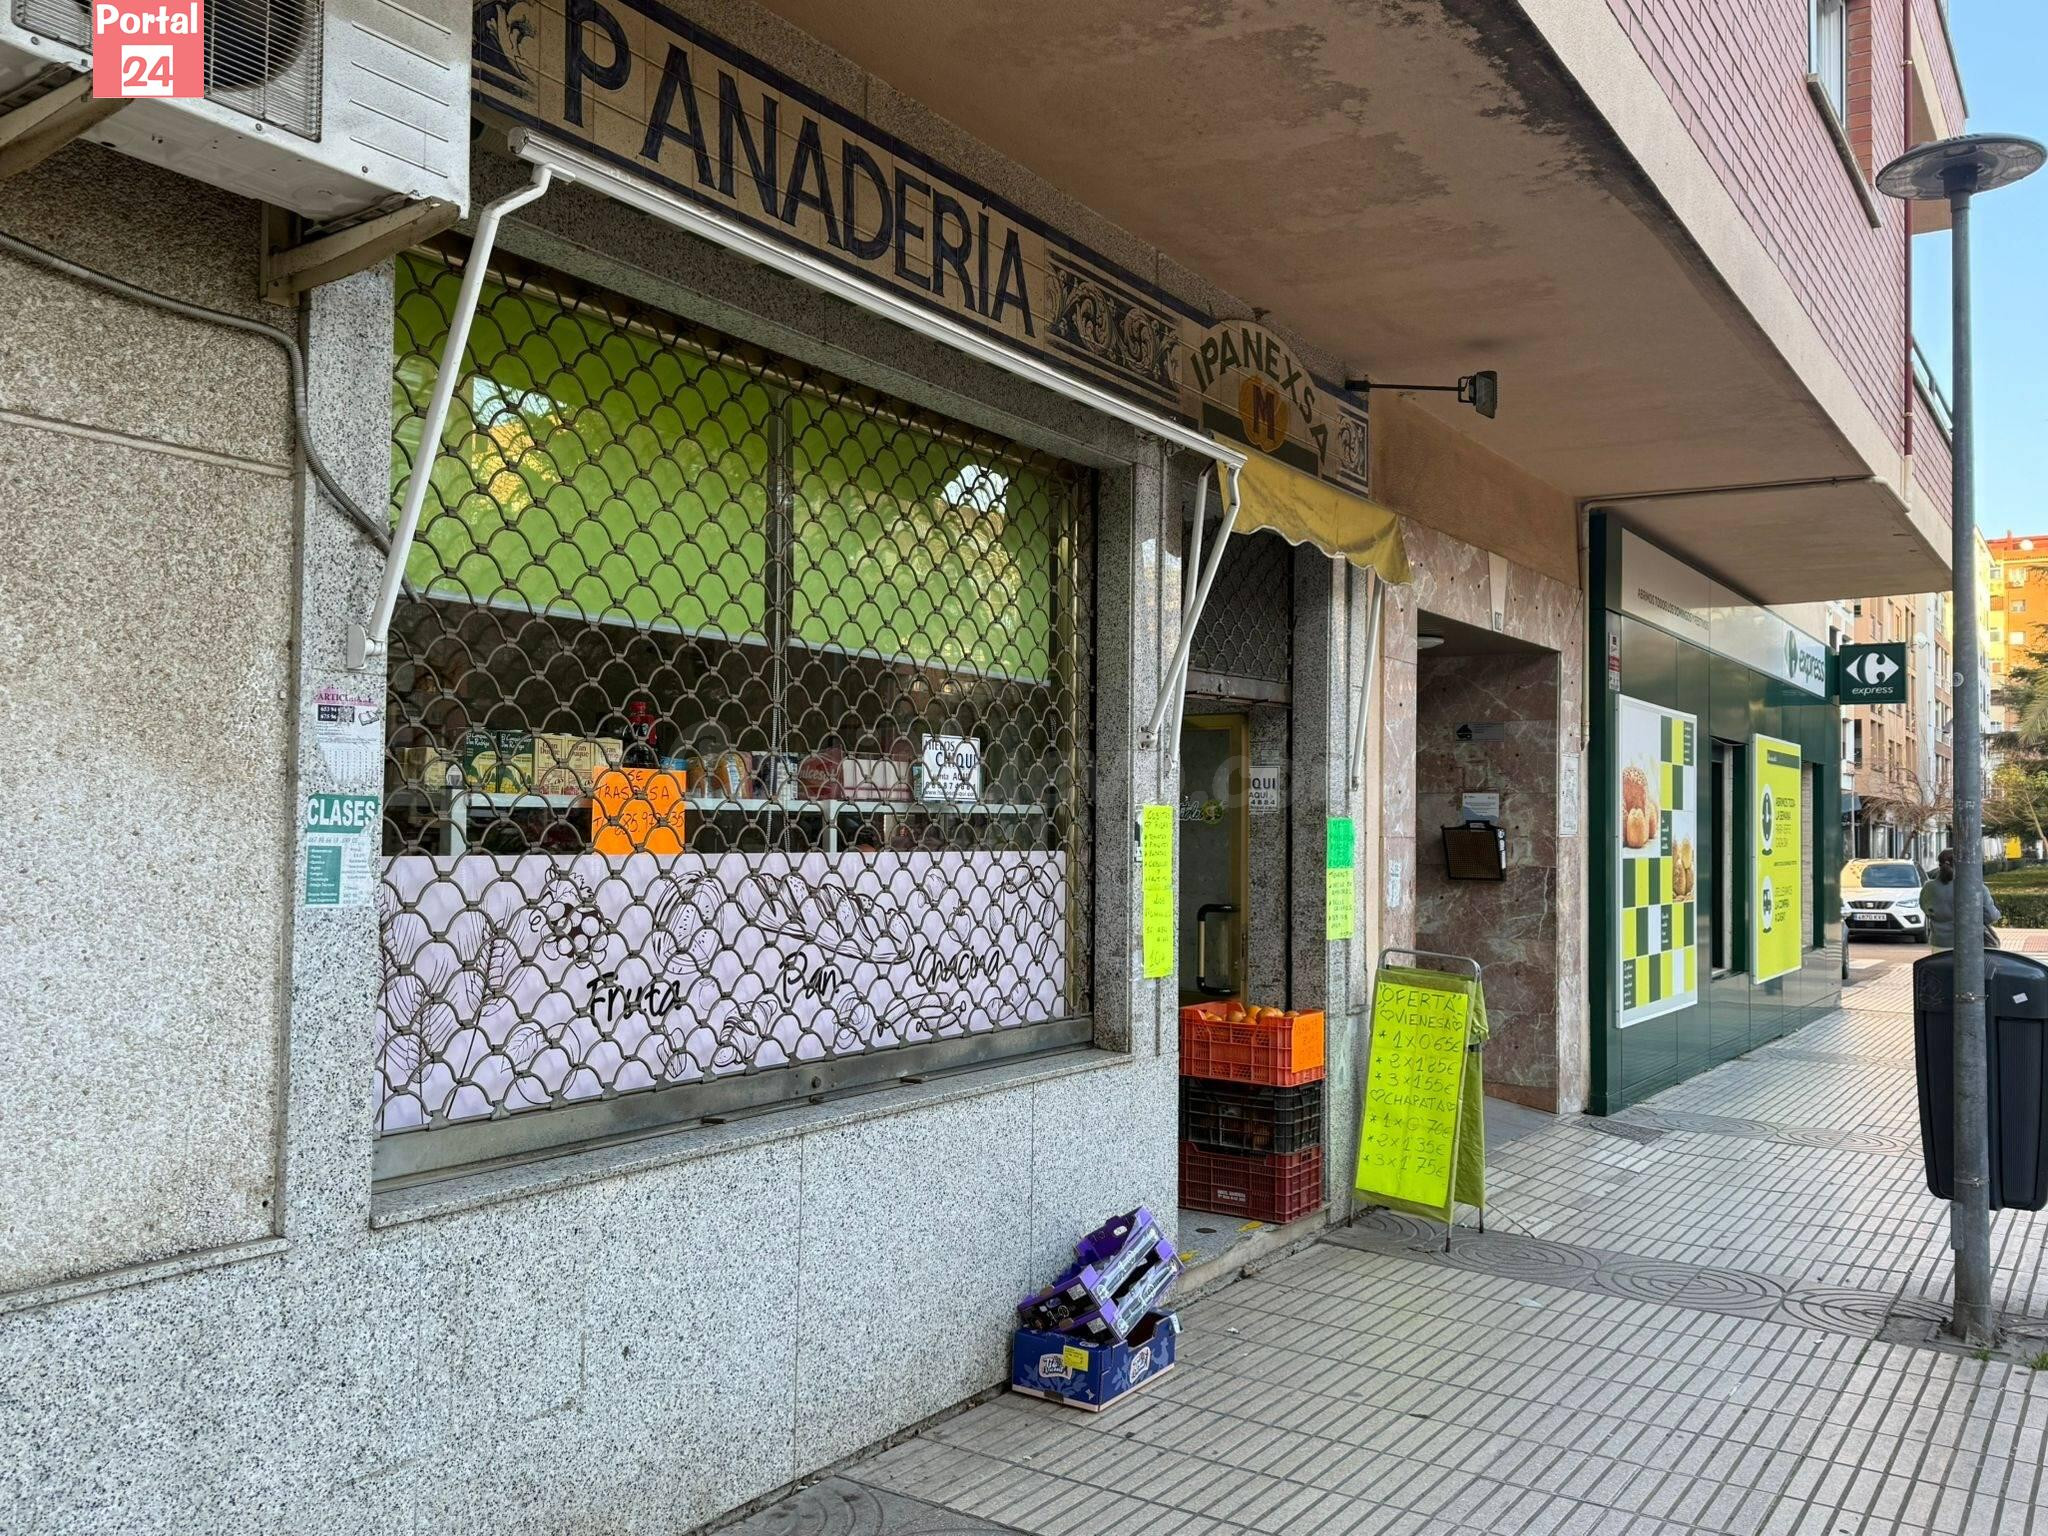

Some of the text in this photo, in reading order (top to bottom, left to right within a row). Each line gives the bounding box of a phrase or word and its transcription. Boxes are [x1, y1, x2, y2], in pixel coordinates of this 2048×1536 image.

[1799, 650, 1824, 683] express
[1852, 686, 1894, 696] express
[628, 769, 643, 781] SE
[307, 798, 376, 827] CLASES
[778, 953, 840, 1004] Pan
[587, 970, 682, 1026] Fruta
[1395, 1010, 1451, 1030] VIENESA
[1384, 1092, 1445, 1112] CHAPATA
